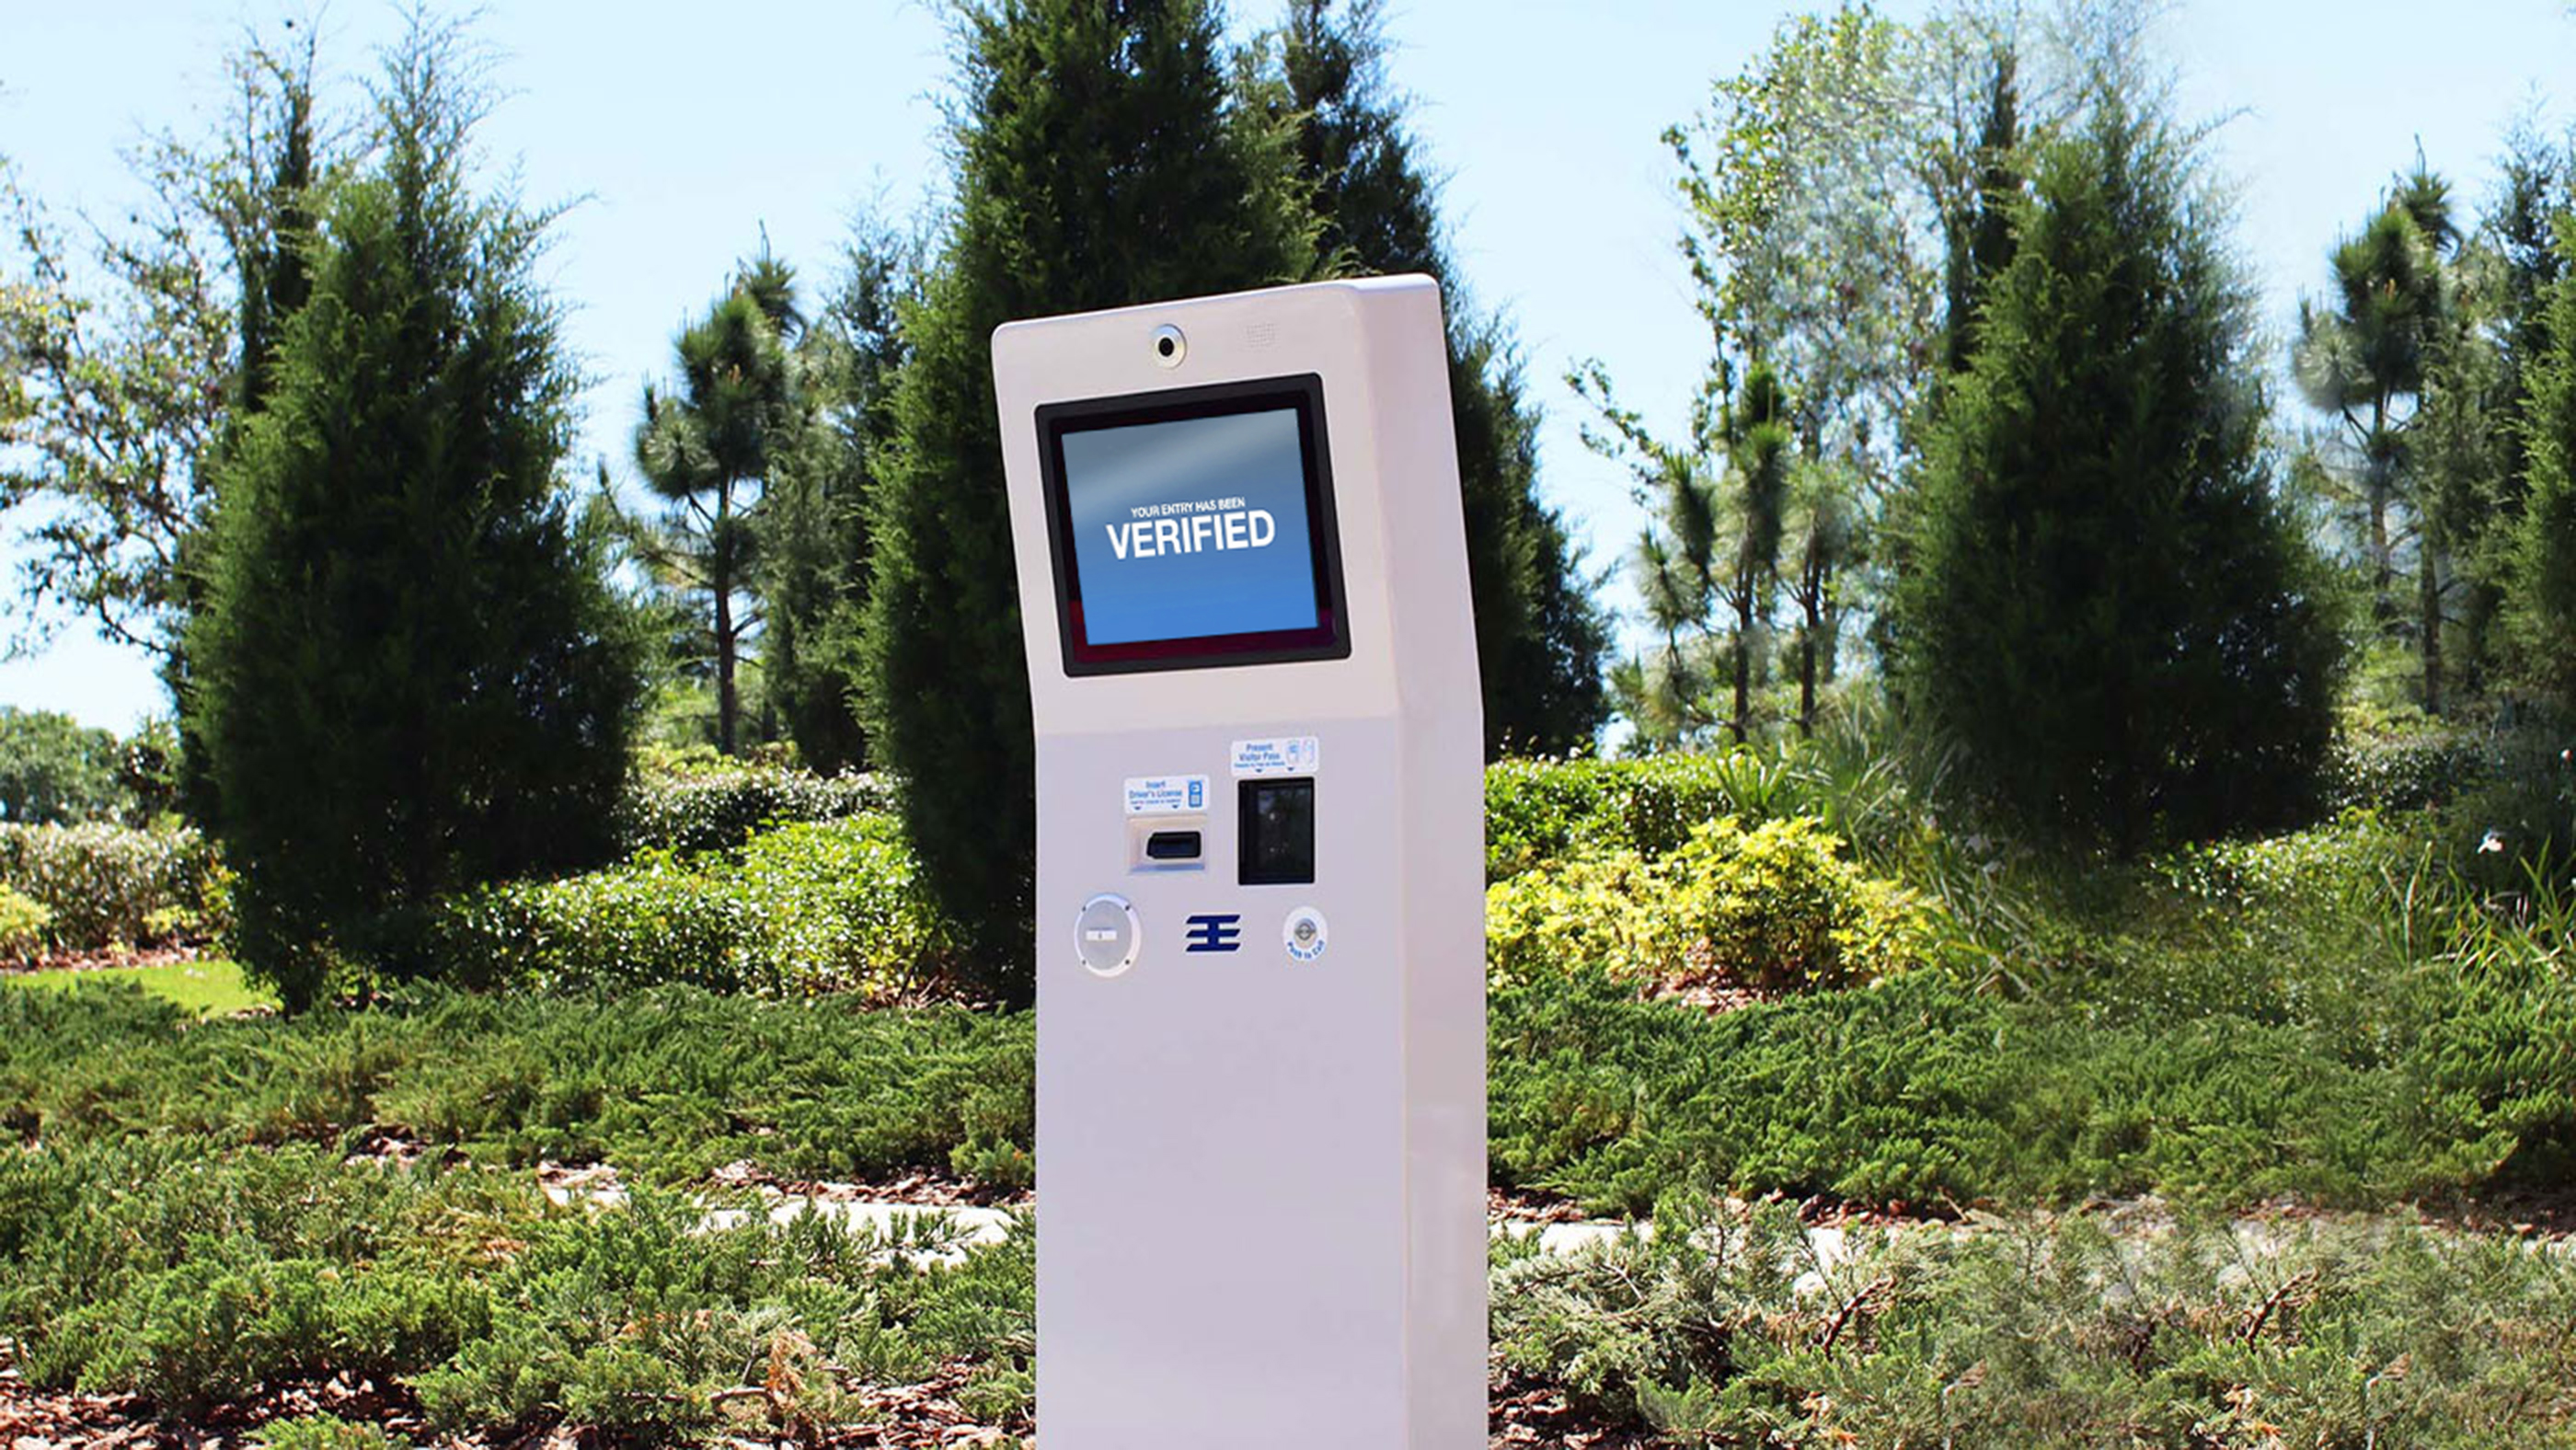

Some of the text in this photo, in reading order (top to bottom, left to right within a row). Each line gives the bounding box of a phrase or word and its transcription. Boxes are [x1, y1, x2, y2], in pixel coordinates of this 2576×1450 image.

[1131, 497, 1245, 518] YOUR ENTRY HAS BEEN
[1106, 510, 1275, 559] VERIFIED
[1247, 742, 1273, 752] Present
[1238, 751, 1281, 762] Visitor Pass
[1145, 780, 1166, 788] Insert
[1129, 788, 1182, 799] Driver's License
[1287, 941, 1302, 959] Push
[1312, 939, 1325, 955] Call
